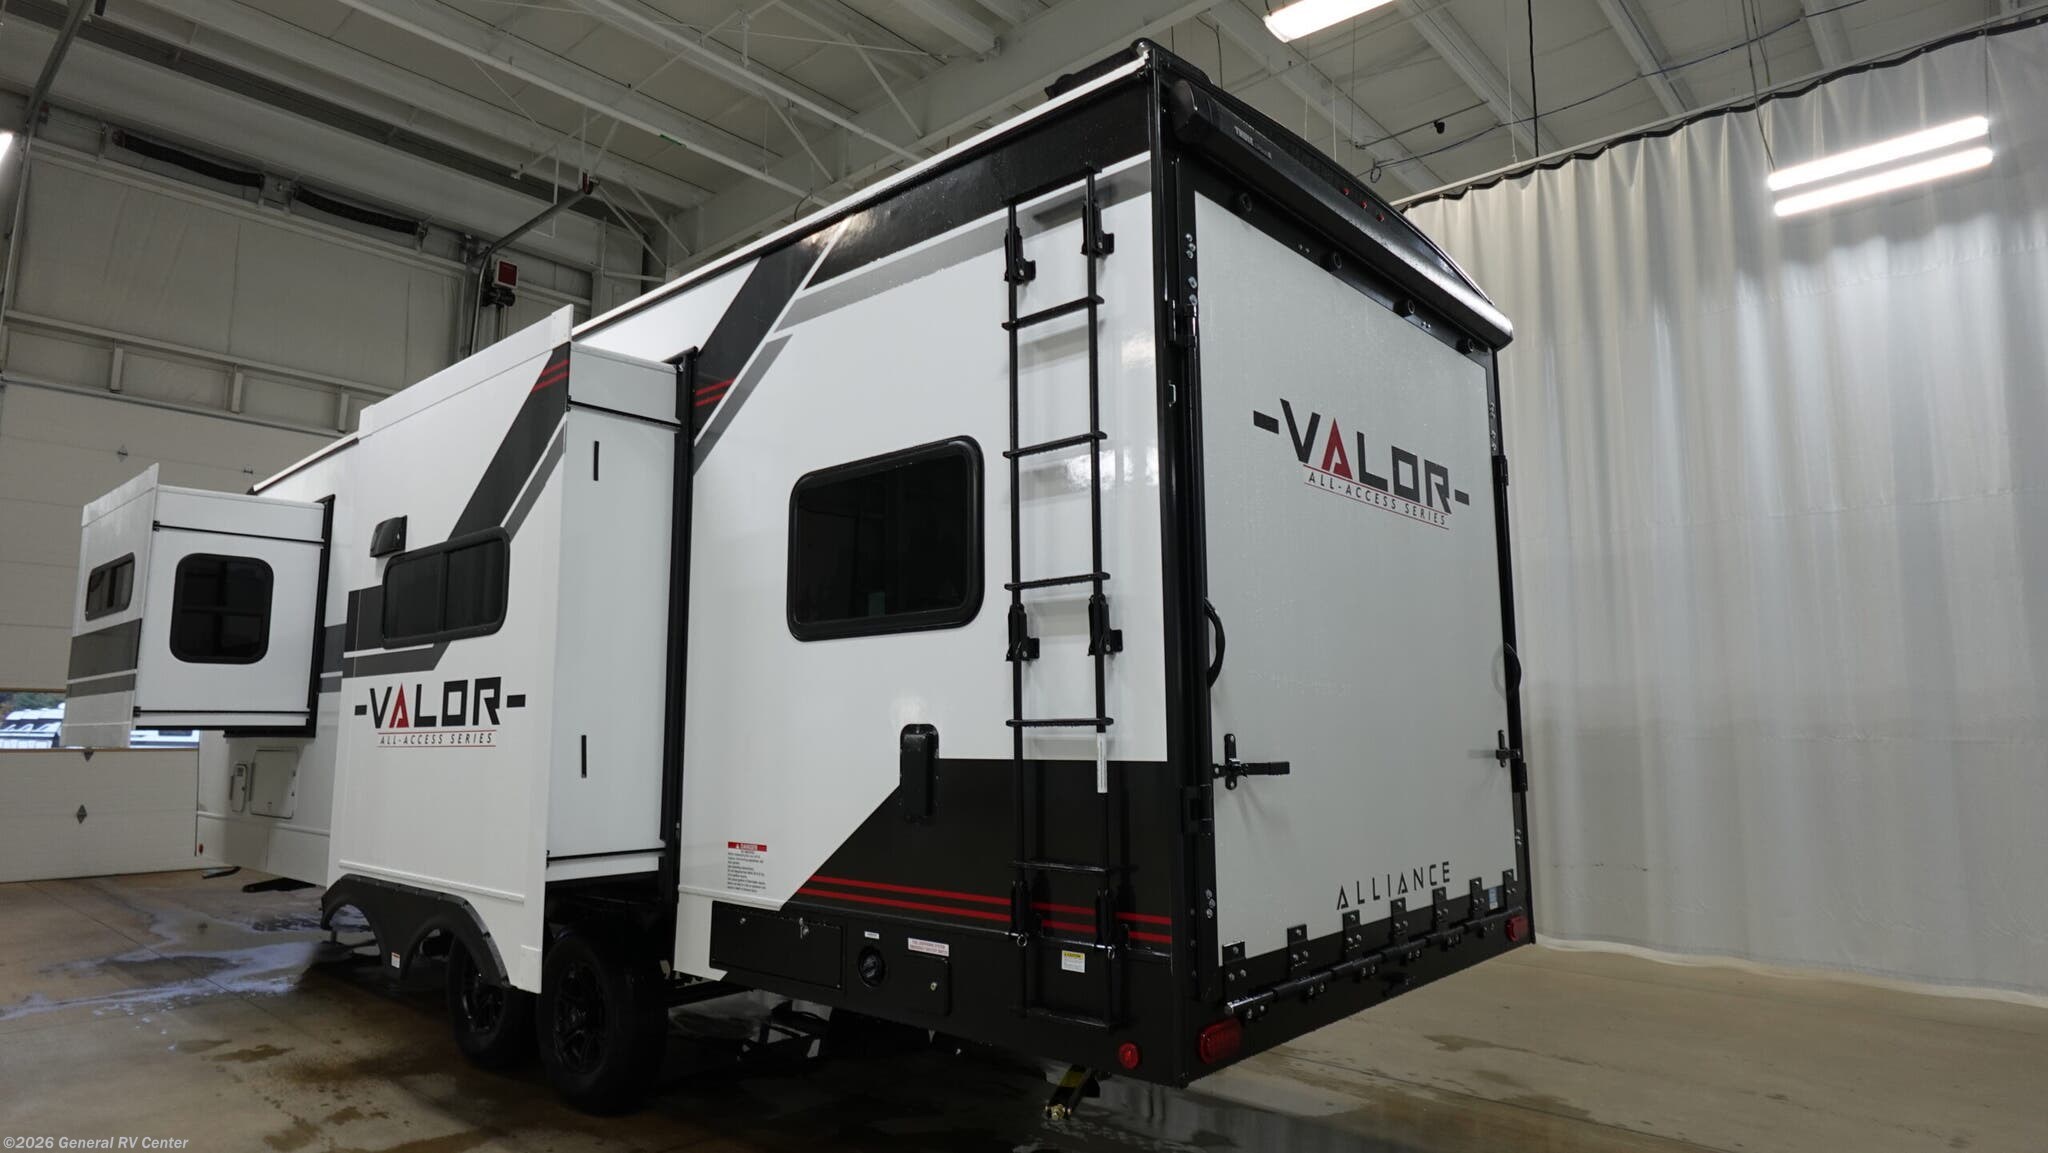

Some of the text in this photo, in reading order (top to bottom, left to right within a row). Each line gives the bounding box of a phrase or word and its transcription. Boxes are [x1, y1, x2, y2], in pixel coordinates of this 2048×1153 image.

[1308, 471, 1447, 526] ALL-ACCESS SERIES
[379, 732, 493, 746] ALL-ACCESS SERIES
[1336, 861, 1450, 911] ALLIANCE
